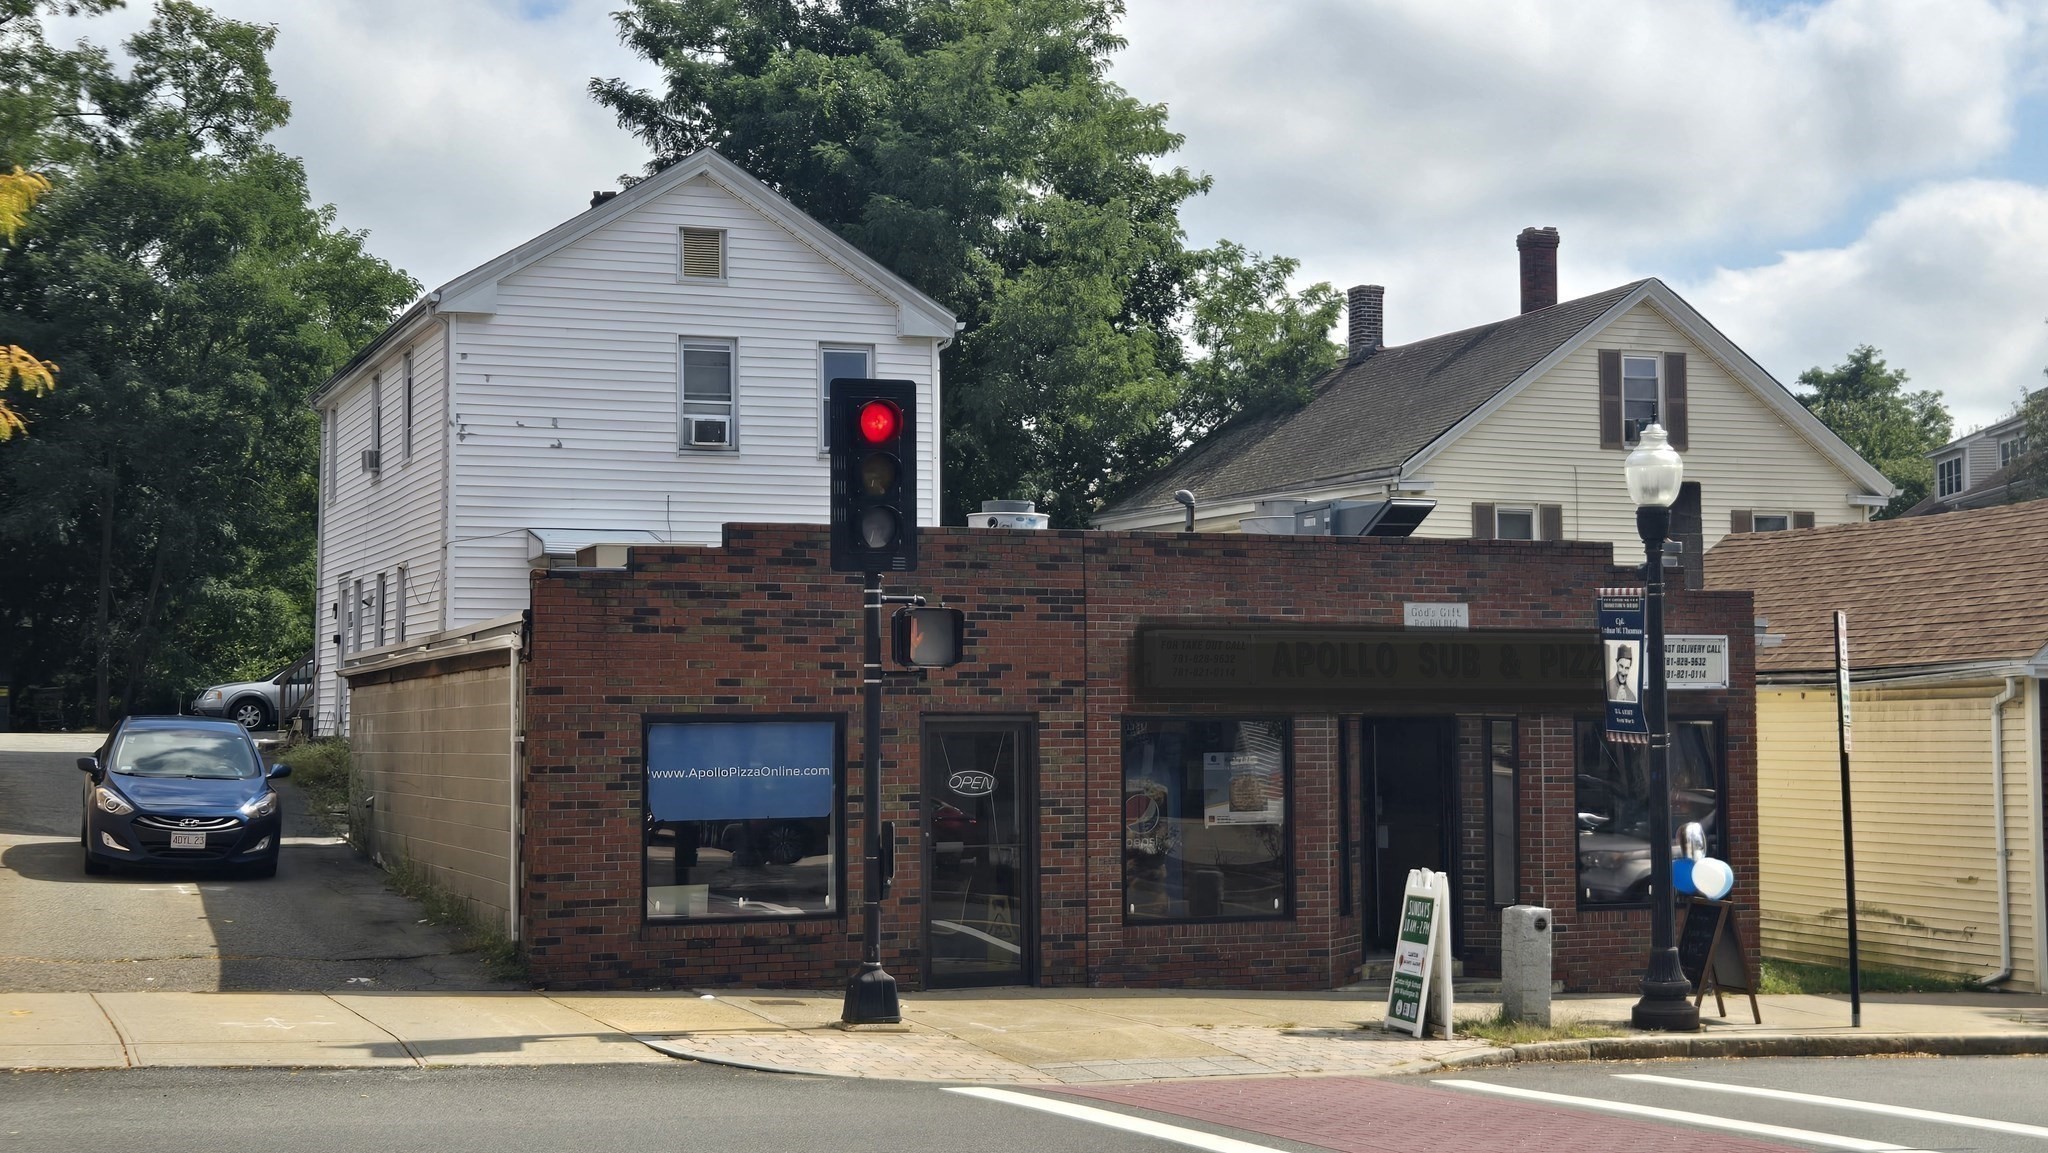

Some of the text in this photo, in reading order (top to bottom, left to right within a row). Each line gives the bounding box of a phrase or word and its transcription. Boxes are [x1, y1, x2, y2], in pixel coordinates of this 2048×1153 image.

[1161, 640, 1246, 651] FOR TAKE OUT CALL
[1676, 644, 1705, 654] DELIVERY
[1706, 645, 1721, 654] CALL
[1272, 641, 1602, 680] APOLLO SUB & PIZZ
[1664, 657, 1706, 666] 81-828-9632
[1665, 669, 1706, 679] 81-821-0114
[651, 765, 831, 779] www.ApolloPizzaOnline.com
[948, 773, 996, 791] OPEN
[194, 836, 204, 844] 23
